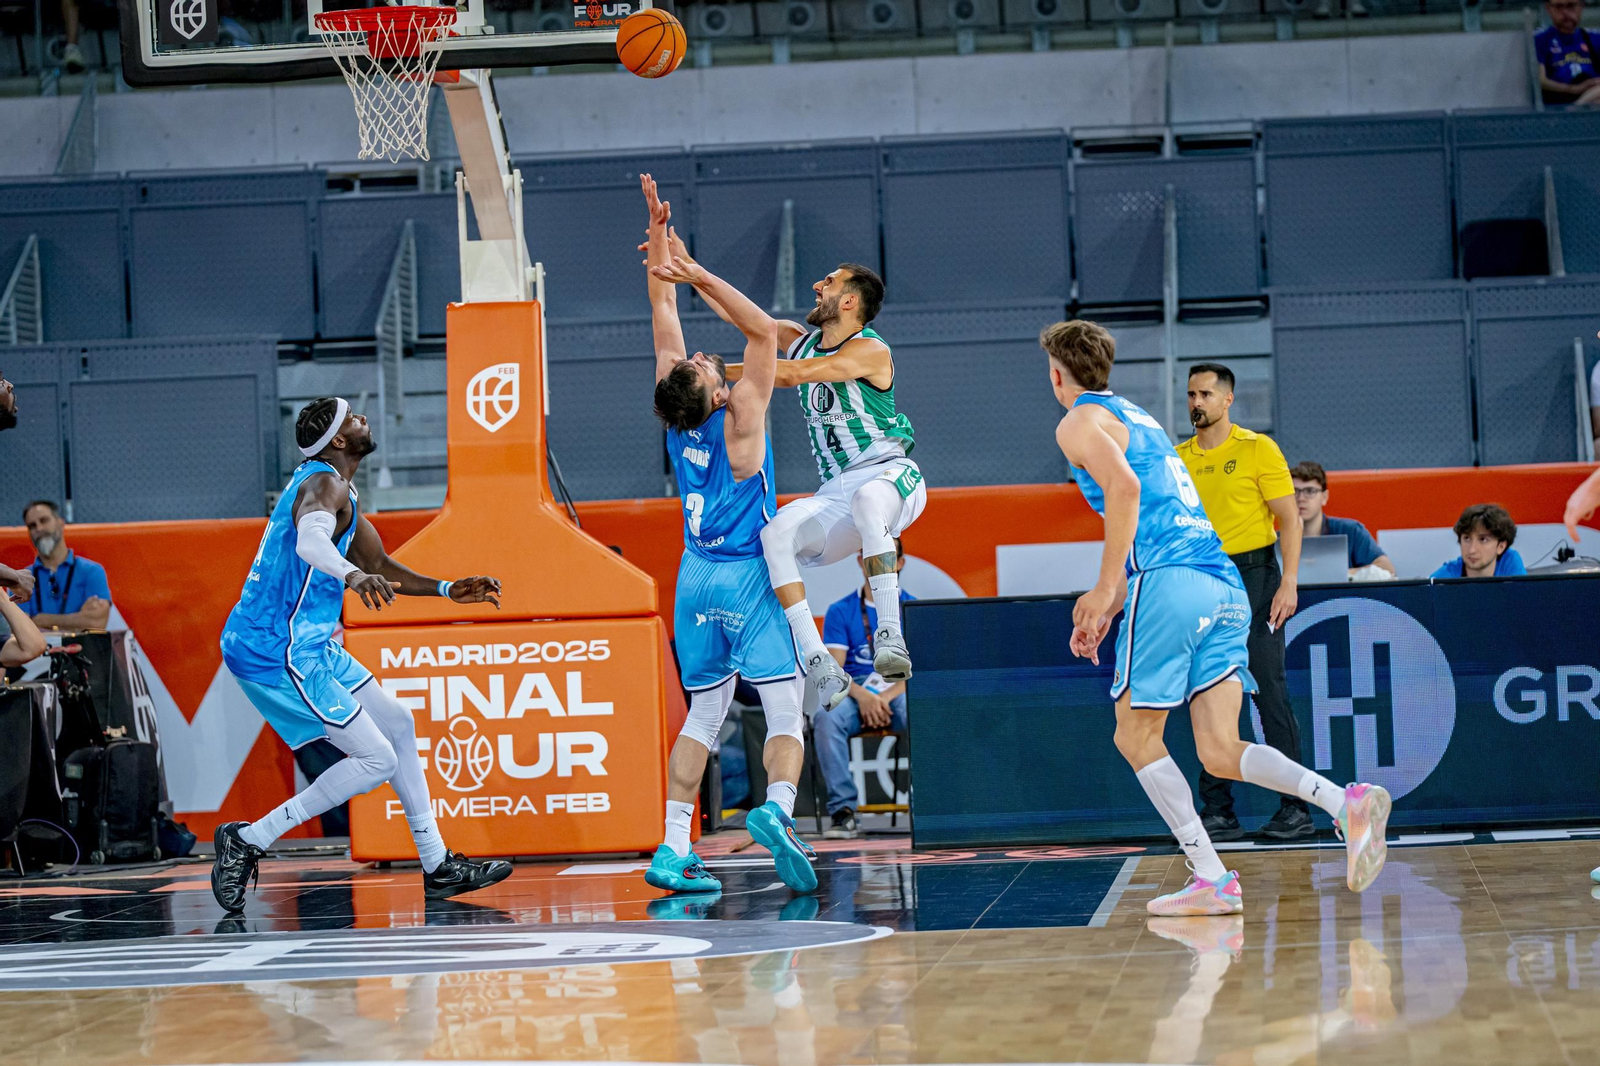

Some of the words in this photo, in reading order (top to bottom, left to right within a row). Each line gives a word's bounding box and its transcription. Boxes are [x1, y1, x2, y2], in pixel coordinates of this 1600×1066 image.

[827, 427, 844, 453] 4
[1165, 455, 1200, 508] 15
[686, 493, 704, 537] 3
[381, 671, 614, 721] FINAL
[386, 795, 538, 820] PIMERA
[546, 792, 611, 814] FEB
